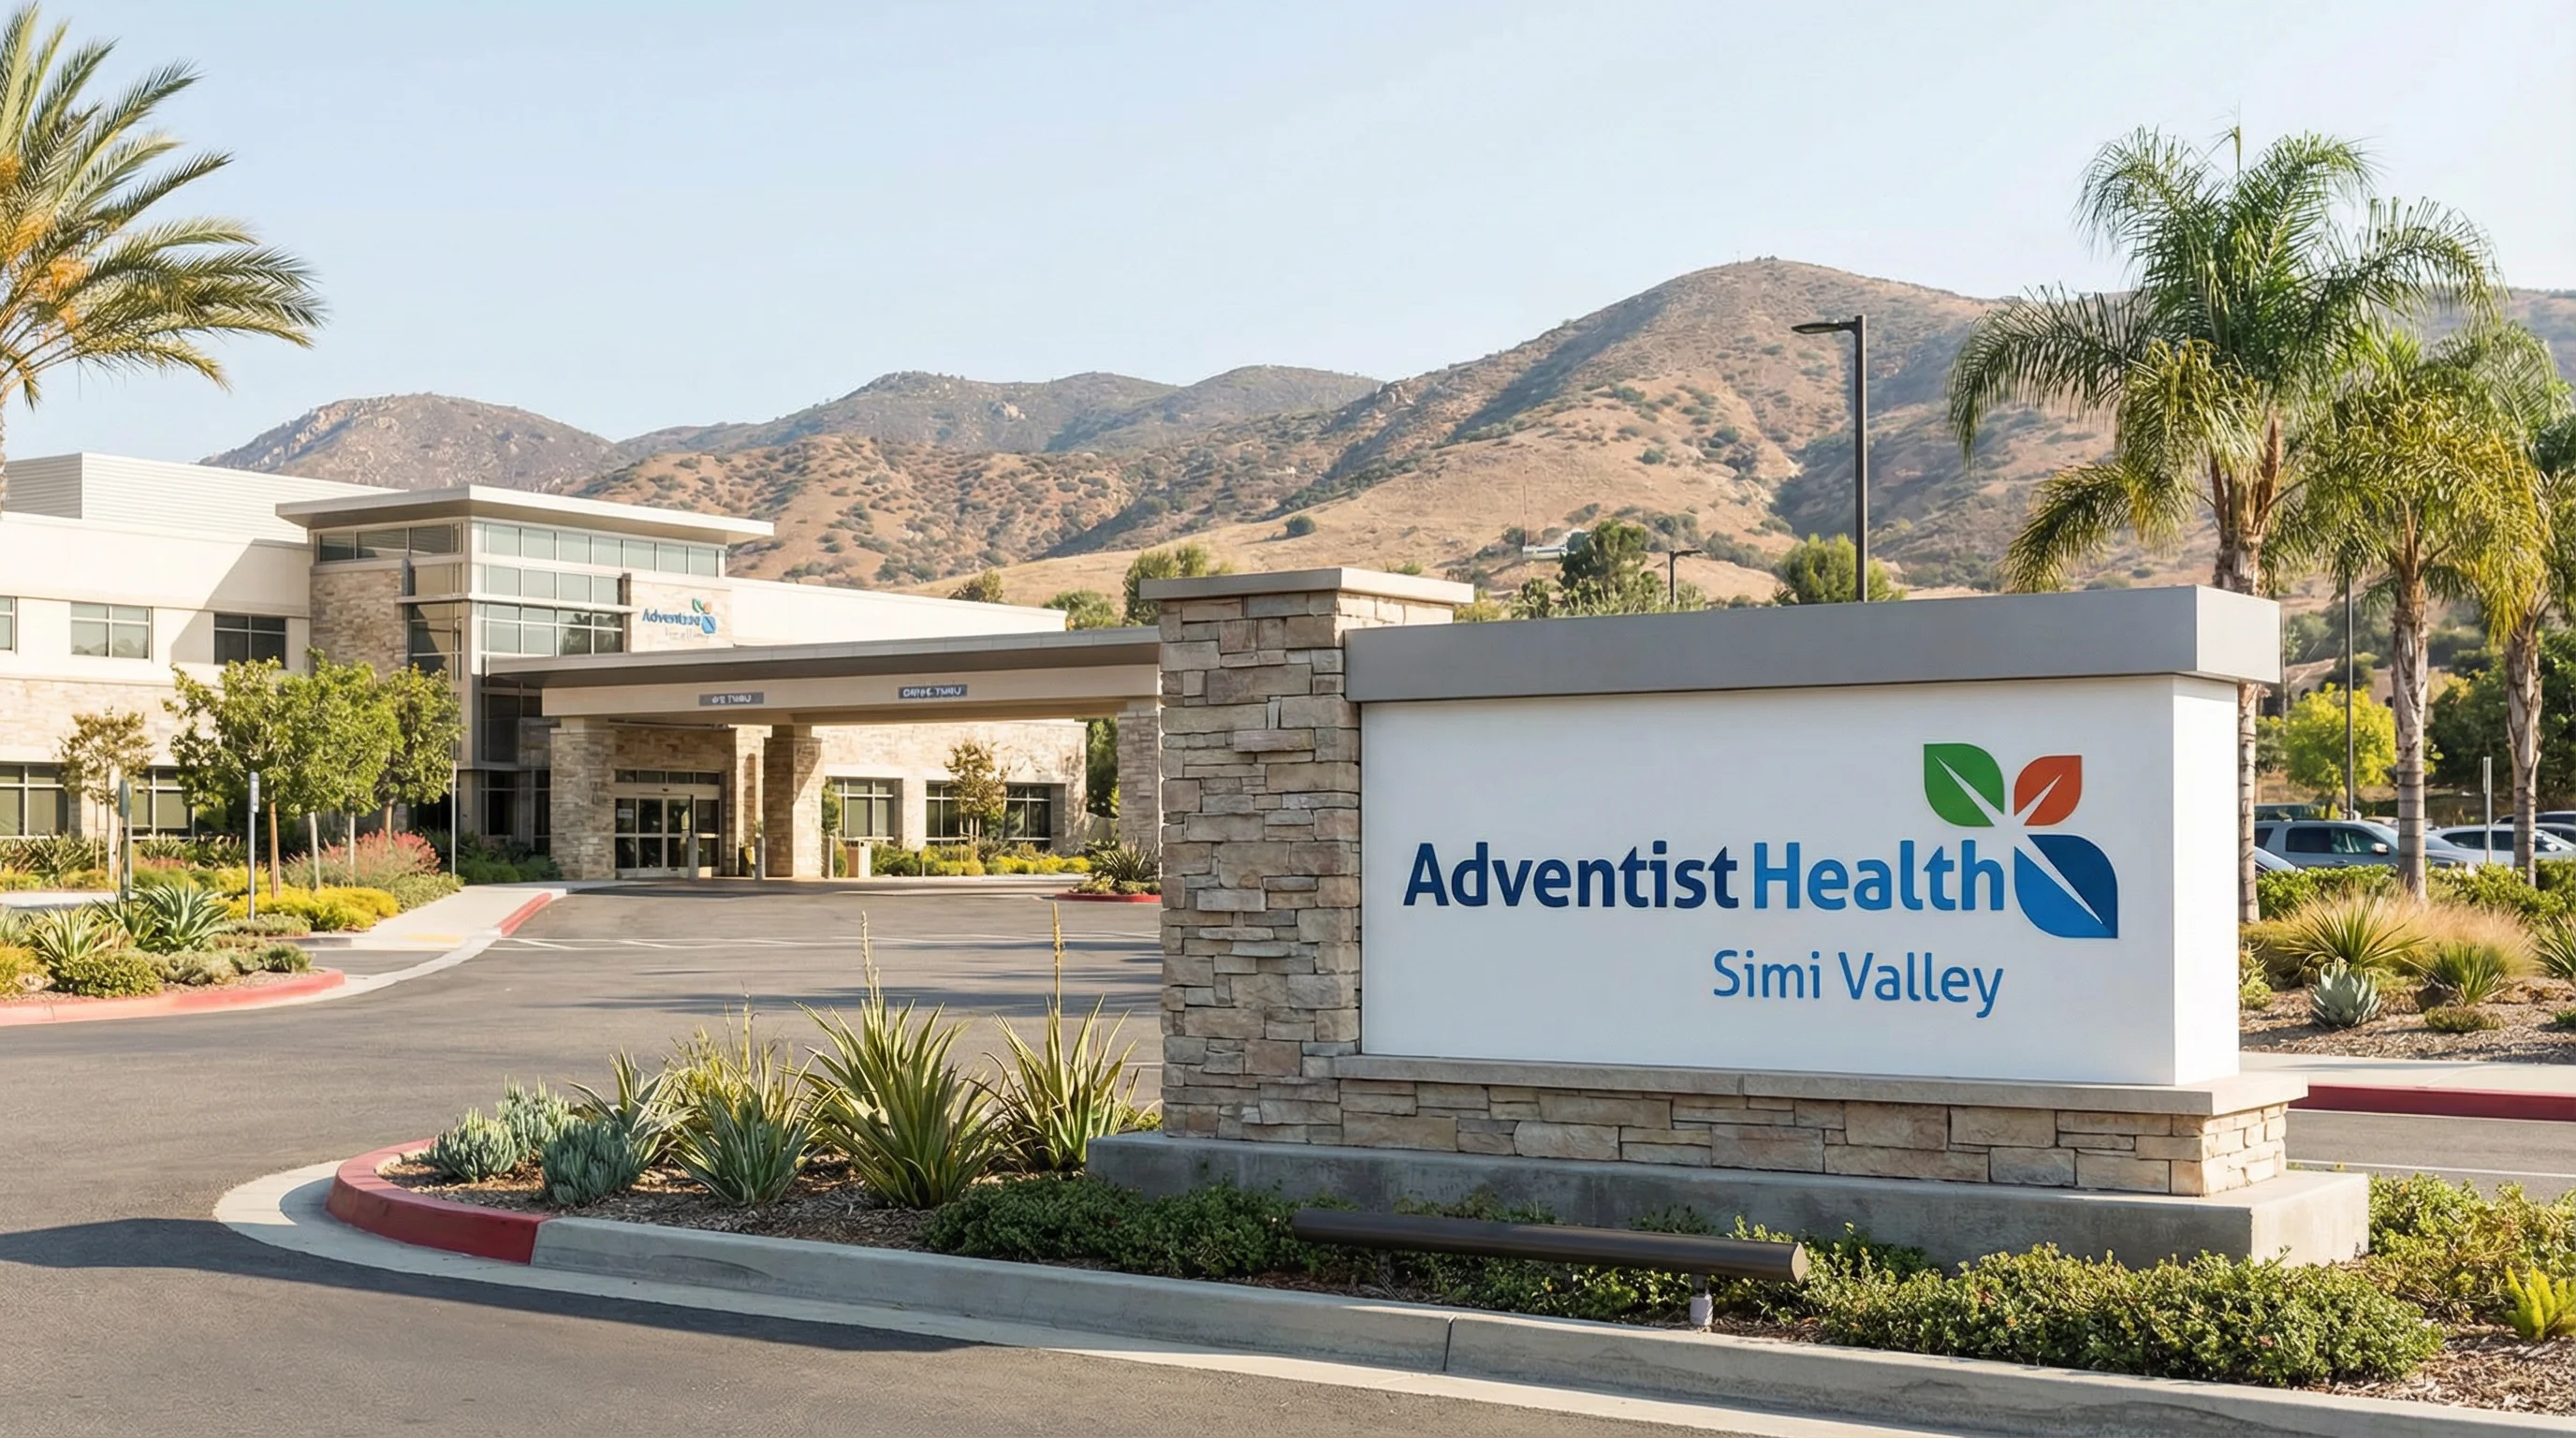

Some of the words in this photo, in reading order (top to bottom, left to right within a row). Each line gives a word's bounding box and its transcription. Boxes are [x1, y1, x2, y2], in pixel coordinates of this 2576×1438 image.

[1403, 840, 1739, 910] Adventist
[1753, 838, 2006, 913] Health
[1712, 948, 1822, 1001] Simi
[1837, 950, 2004, 1020] Valley
